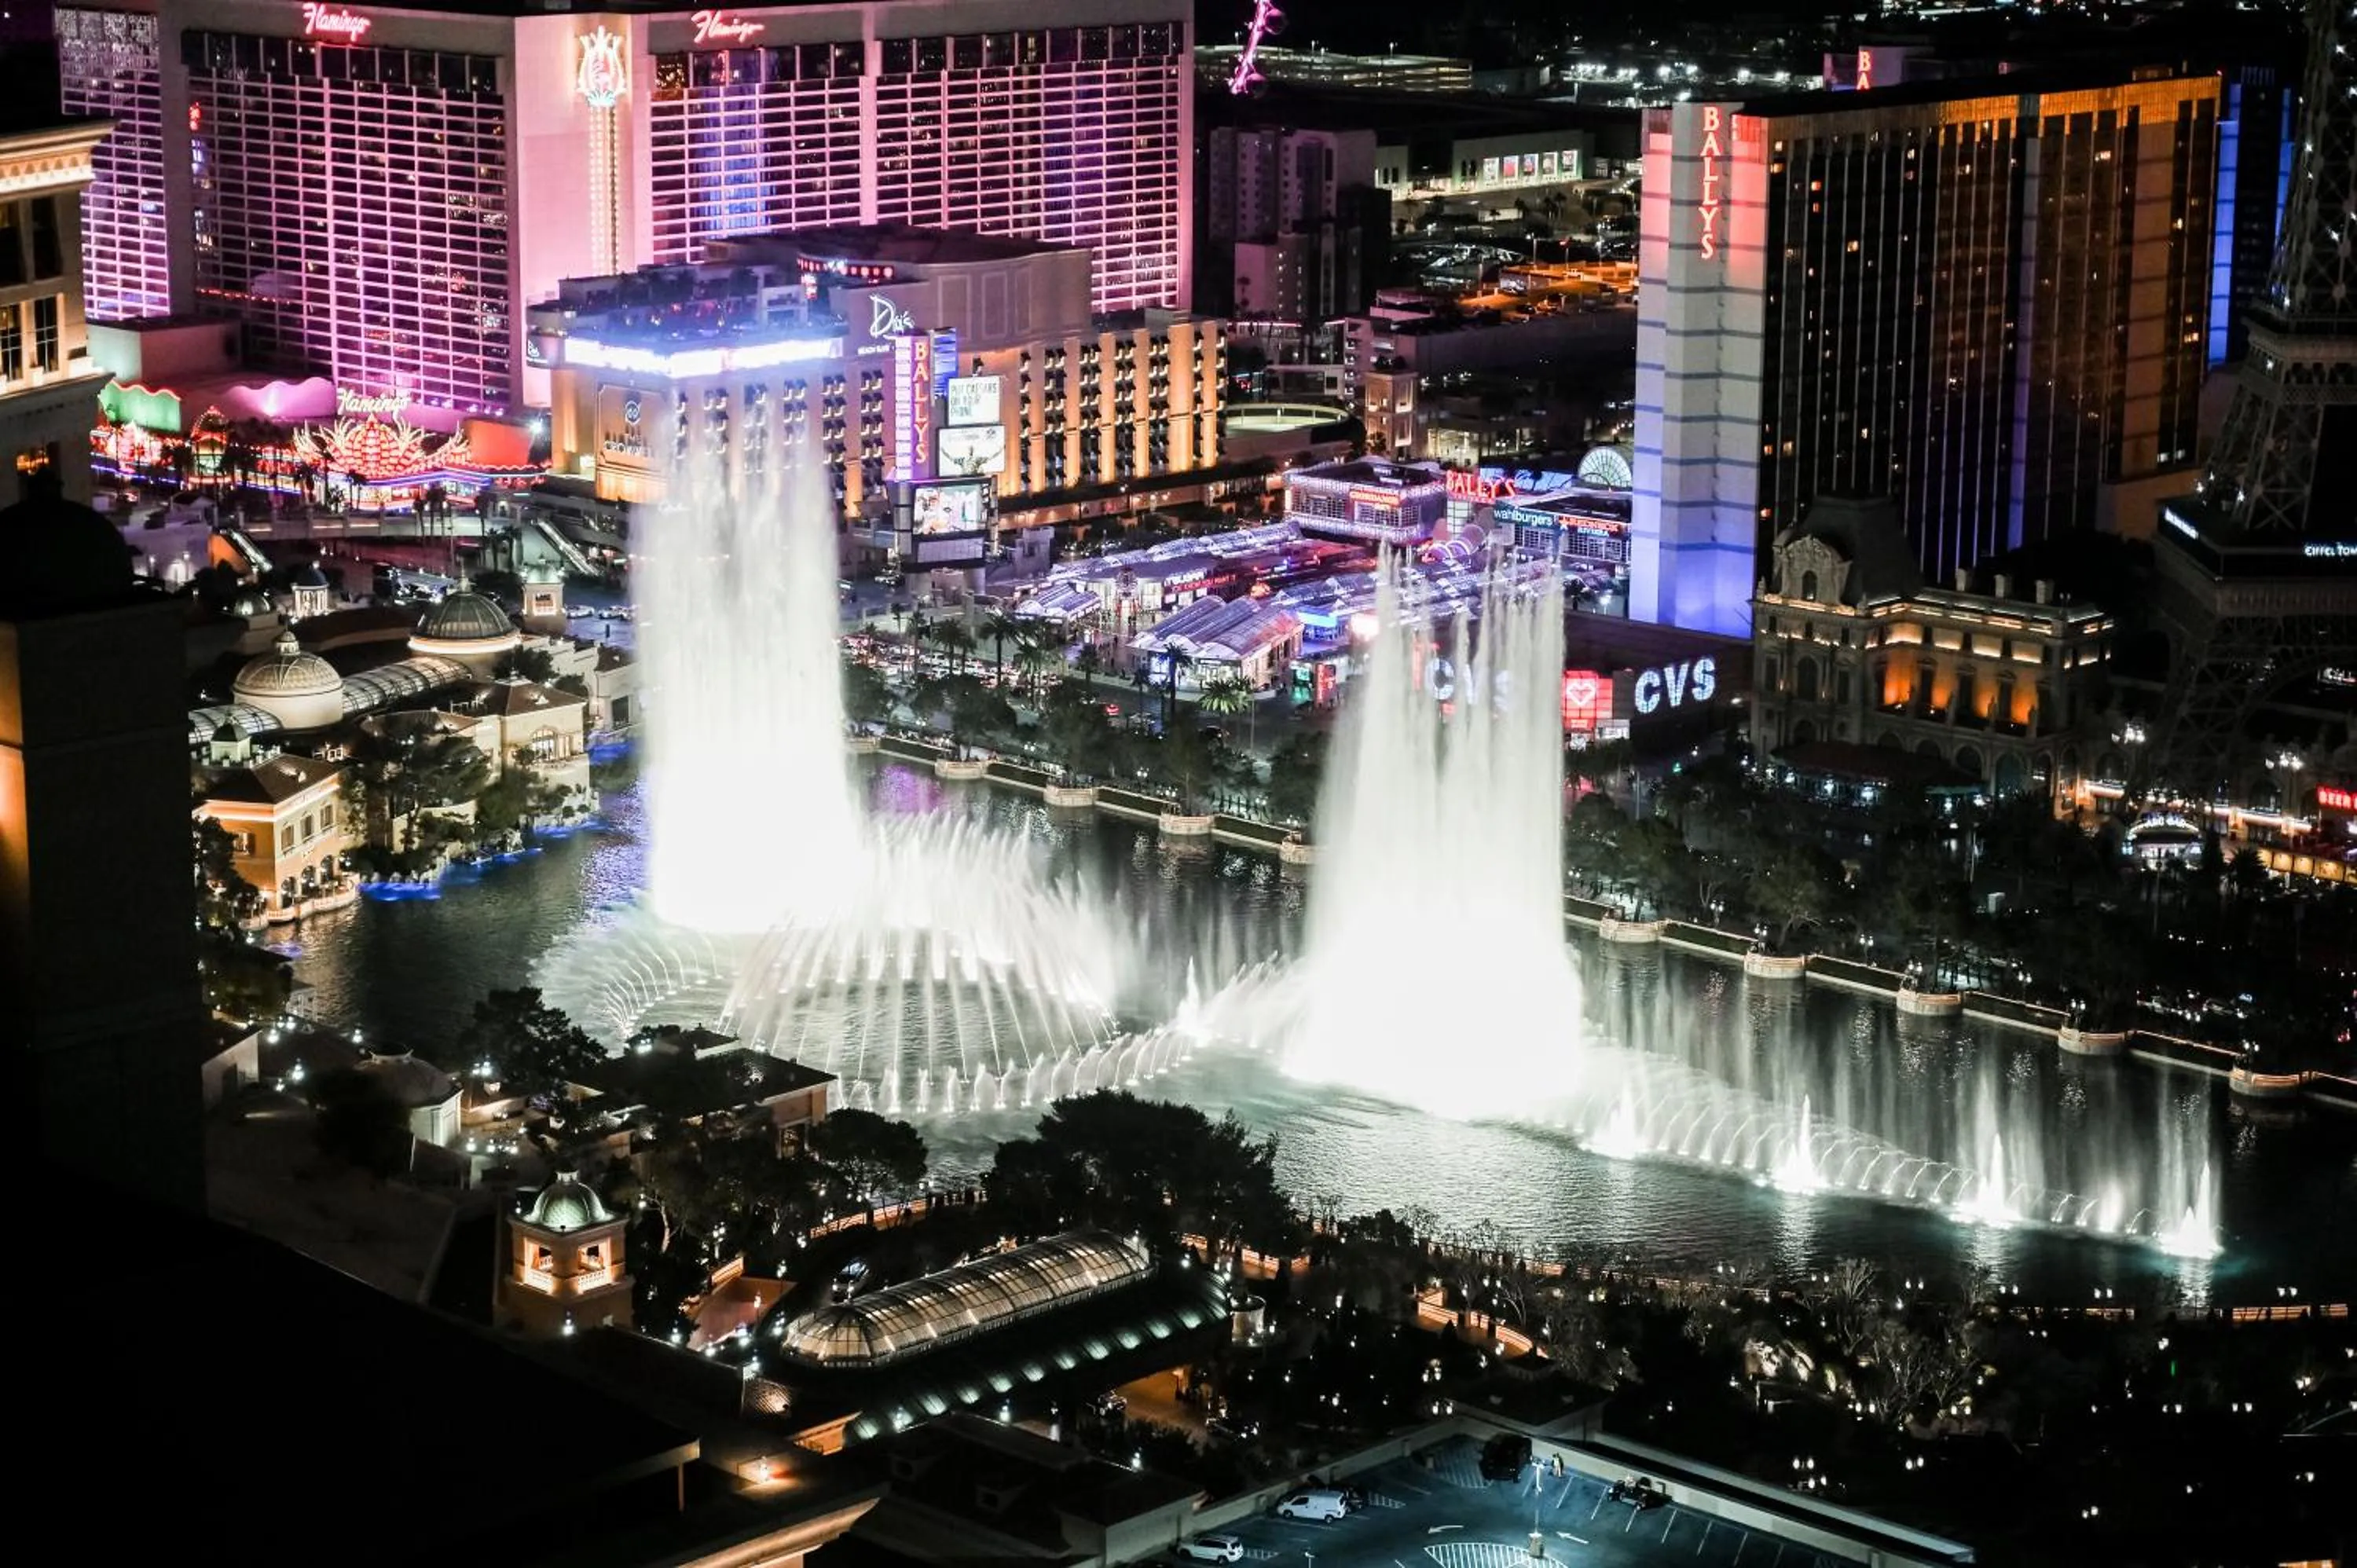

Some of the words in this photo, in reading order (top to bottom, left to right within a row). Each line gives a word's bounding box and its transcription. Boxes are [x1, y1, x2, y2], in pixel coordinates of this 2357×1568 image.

[302, 2, 371, 42] Flamingo
[336, 388, 411, 416] Flamingo
[912, 343, 929, 463] BALLYS
[1494, 509, 1552, 527] wahlburgers
[1635, 658, 1716, 713] CVS
